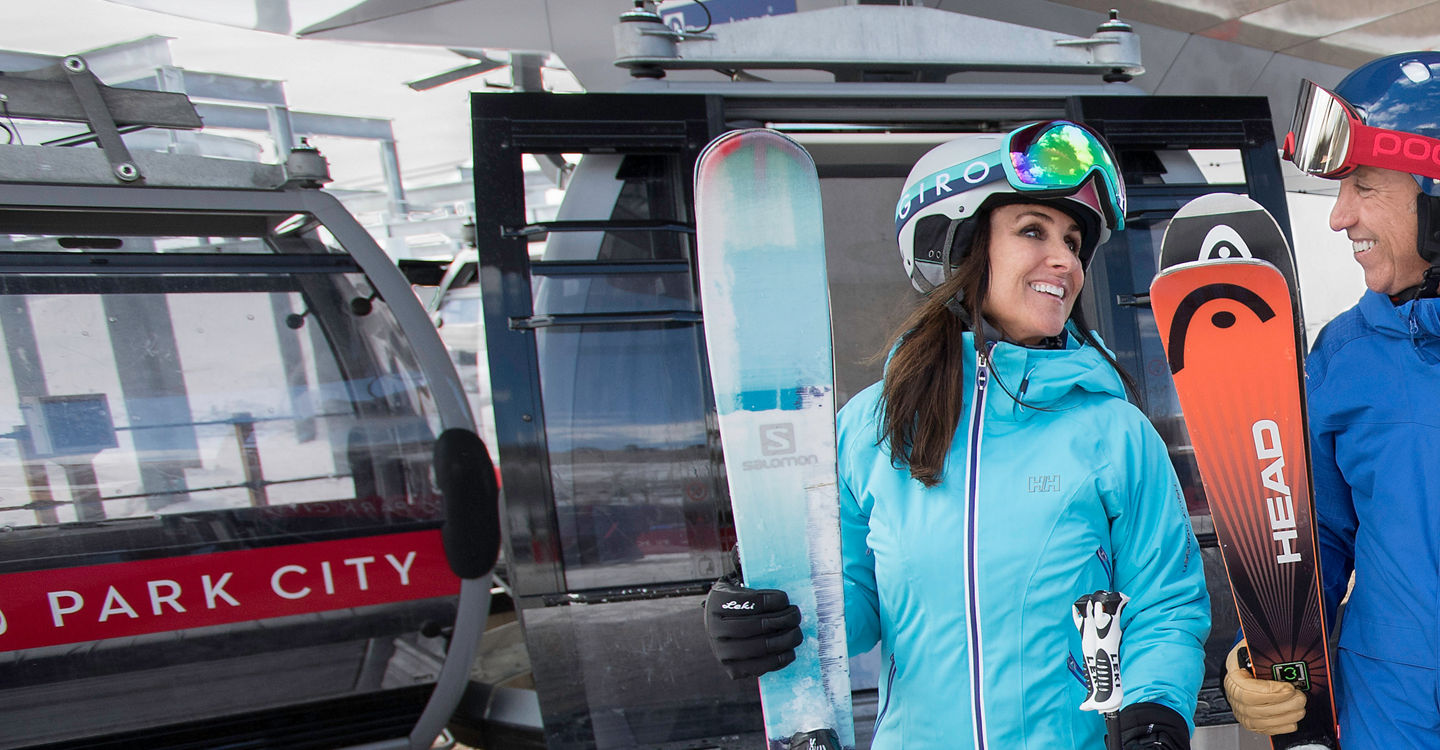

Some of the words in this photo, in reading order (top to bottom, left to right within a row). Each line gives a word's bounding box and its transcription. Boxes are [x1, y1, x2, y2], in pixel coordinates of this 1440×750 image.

[898, 161, 990, 220] GIRO
[1252, 419, 1302, 564] HEAD
[47, 572, 240, 628] PARK
[270, 551, 417, 600] CITY
[722, 600, 755, 610] Leki
[1110, 654, 1121, 688] LEKI
